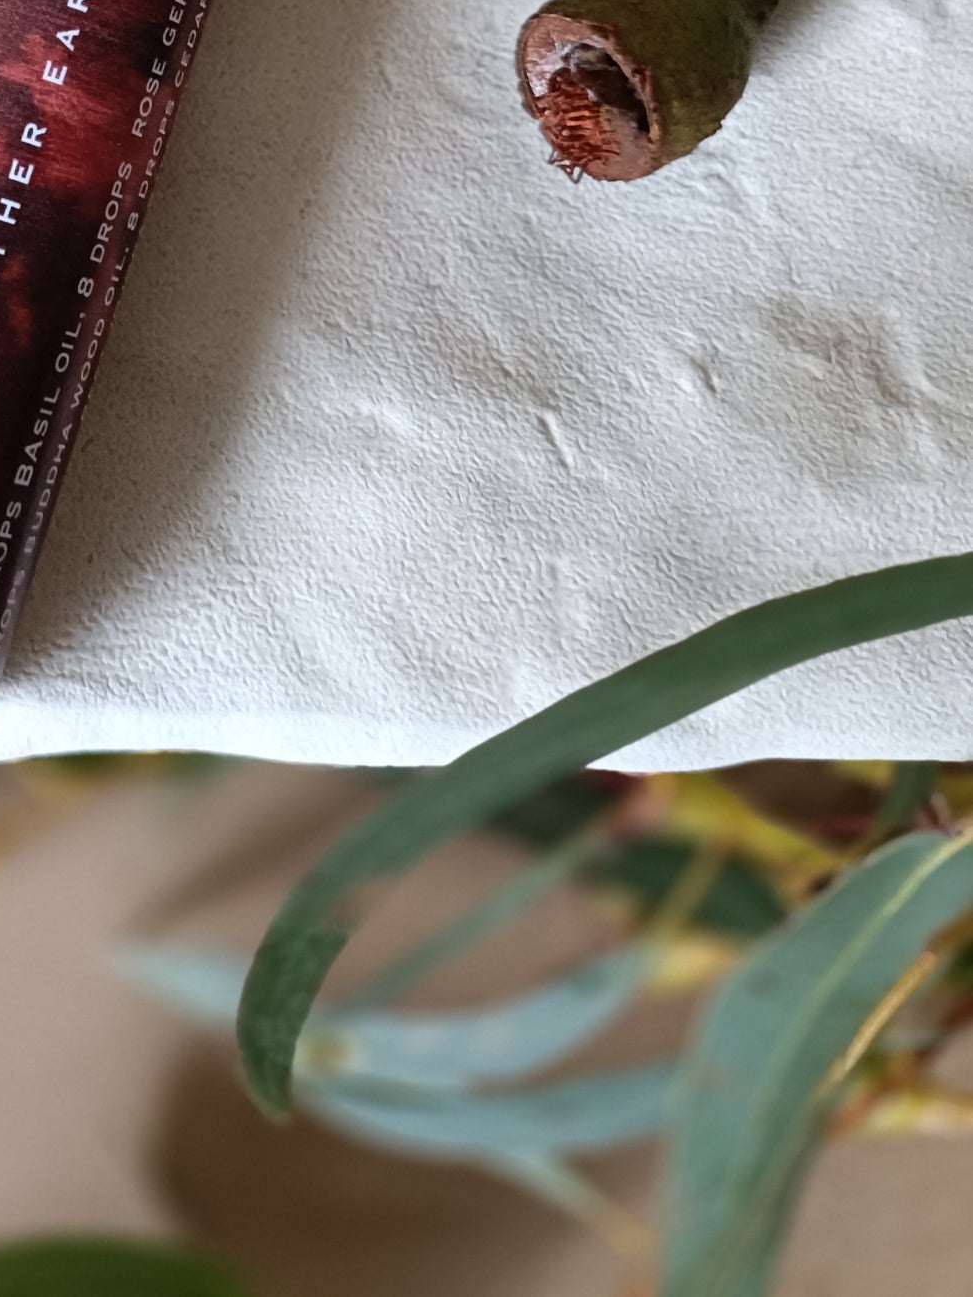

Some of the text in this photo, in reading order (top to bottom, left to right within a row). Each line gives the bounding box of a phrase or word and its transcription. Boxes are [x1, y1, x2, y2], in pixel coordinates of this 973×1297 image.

[14, 386, 61, 487] BASIL
[55, 311, 87, 373] OIL,
[77, 277, 95, 298] 8
[89, 161, 133, 264] DROPS
[131, 57, 168, 138] ROSE
[24, 422, 74, 554] BUDDHA
[70, 318, 106, 409] WOOD
[127, 211, 140, 232] 8
[138, 99, 176, 200] DROPS
